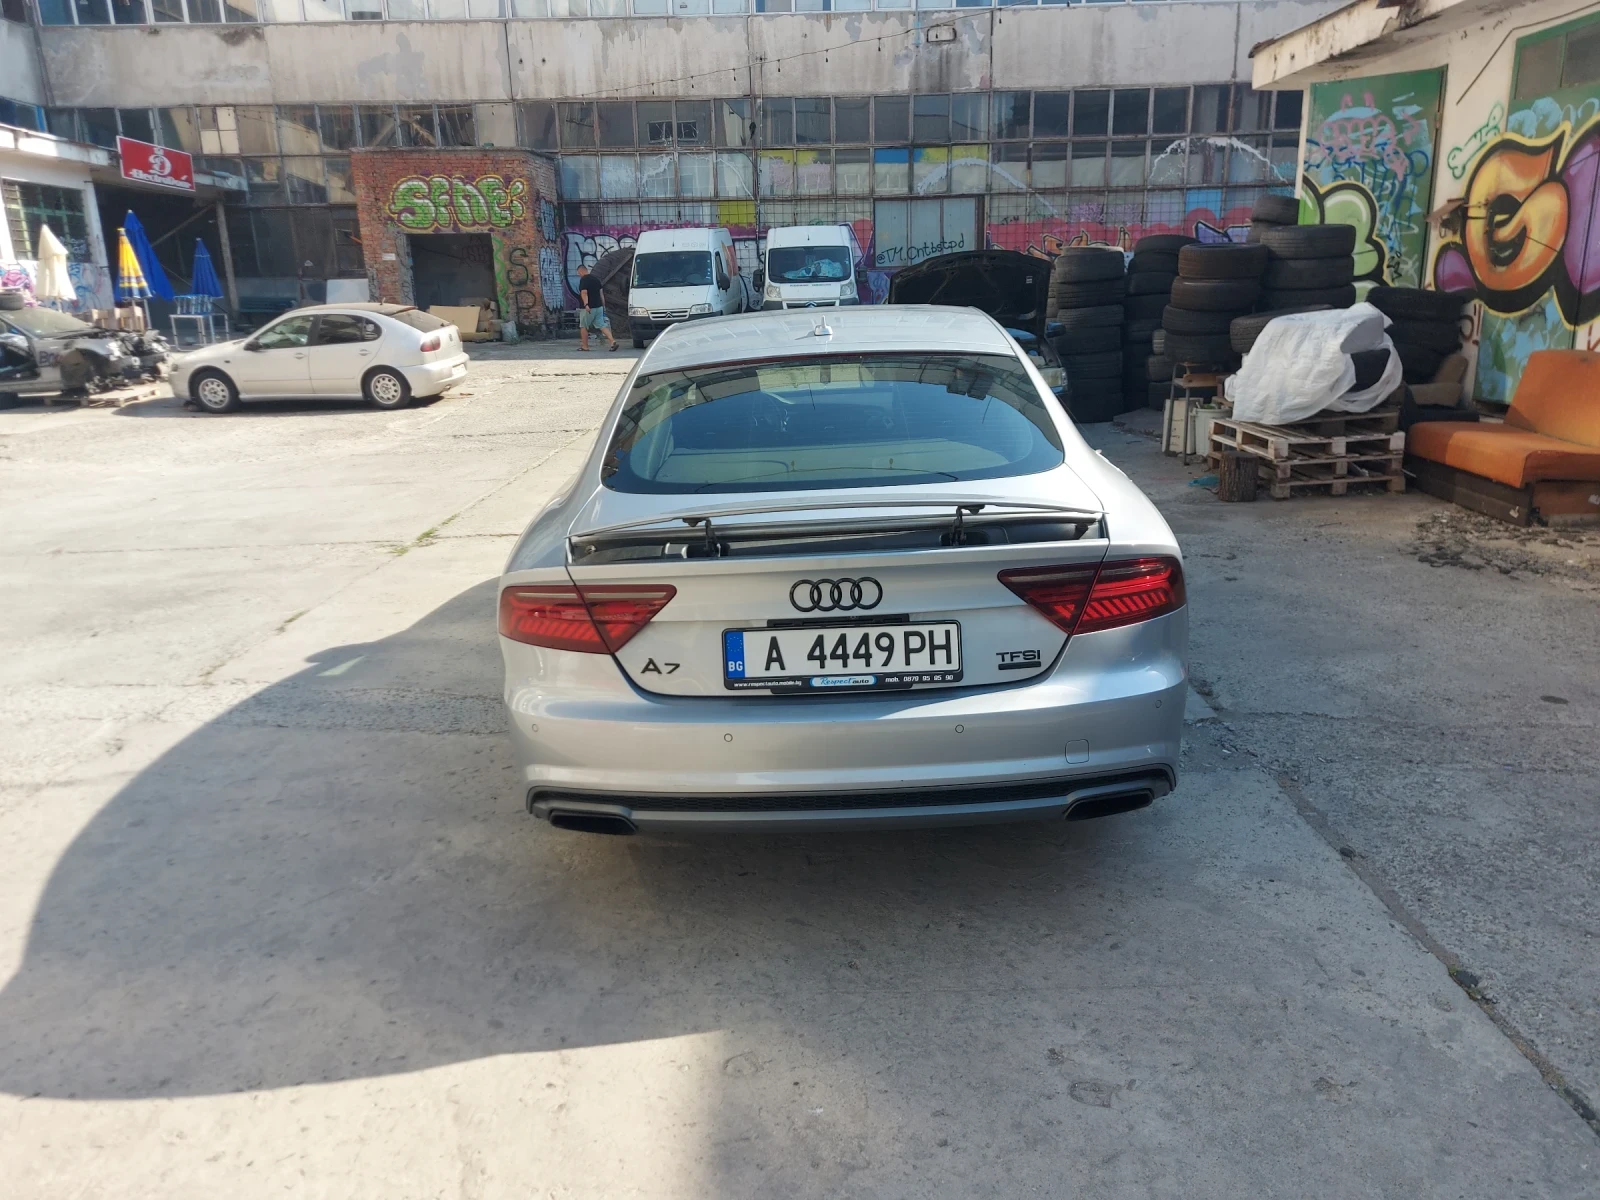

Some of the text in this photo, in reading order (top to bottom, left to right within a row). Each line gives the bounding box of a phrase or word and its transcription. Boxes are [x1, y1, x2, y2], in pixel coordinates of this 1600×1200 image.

[764, 629, 953, 671] A 4449 PH
[996, 649, 1041, 662] TFSI
[640, 658, 681, 674] A7
[728, 661, 743, 671] BG
